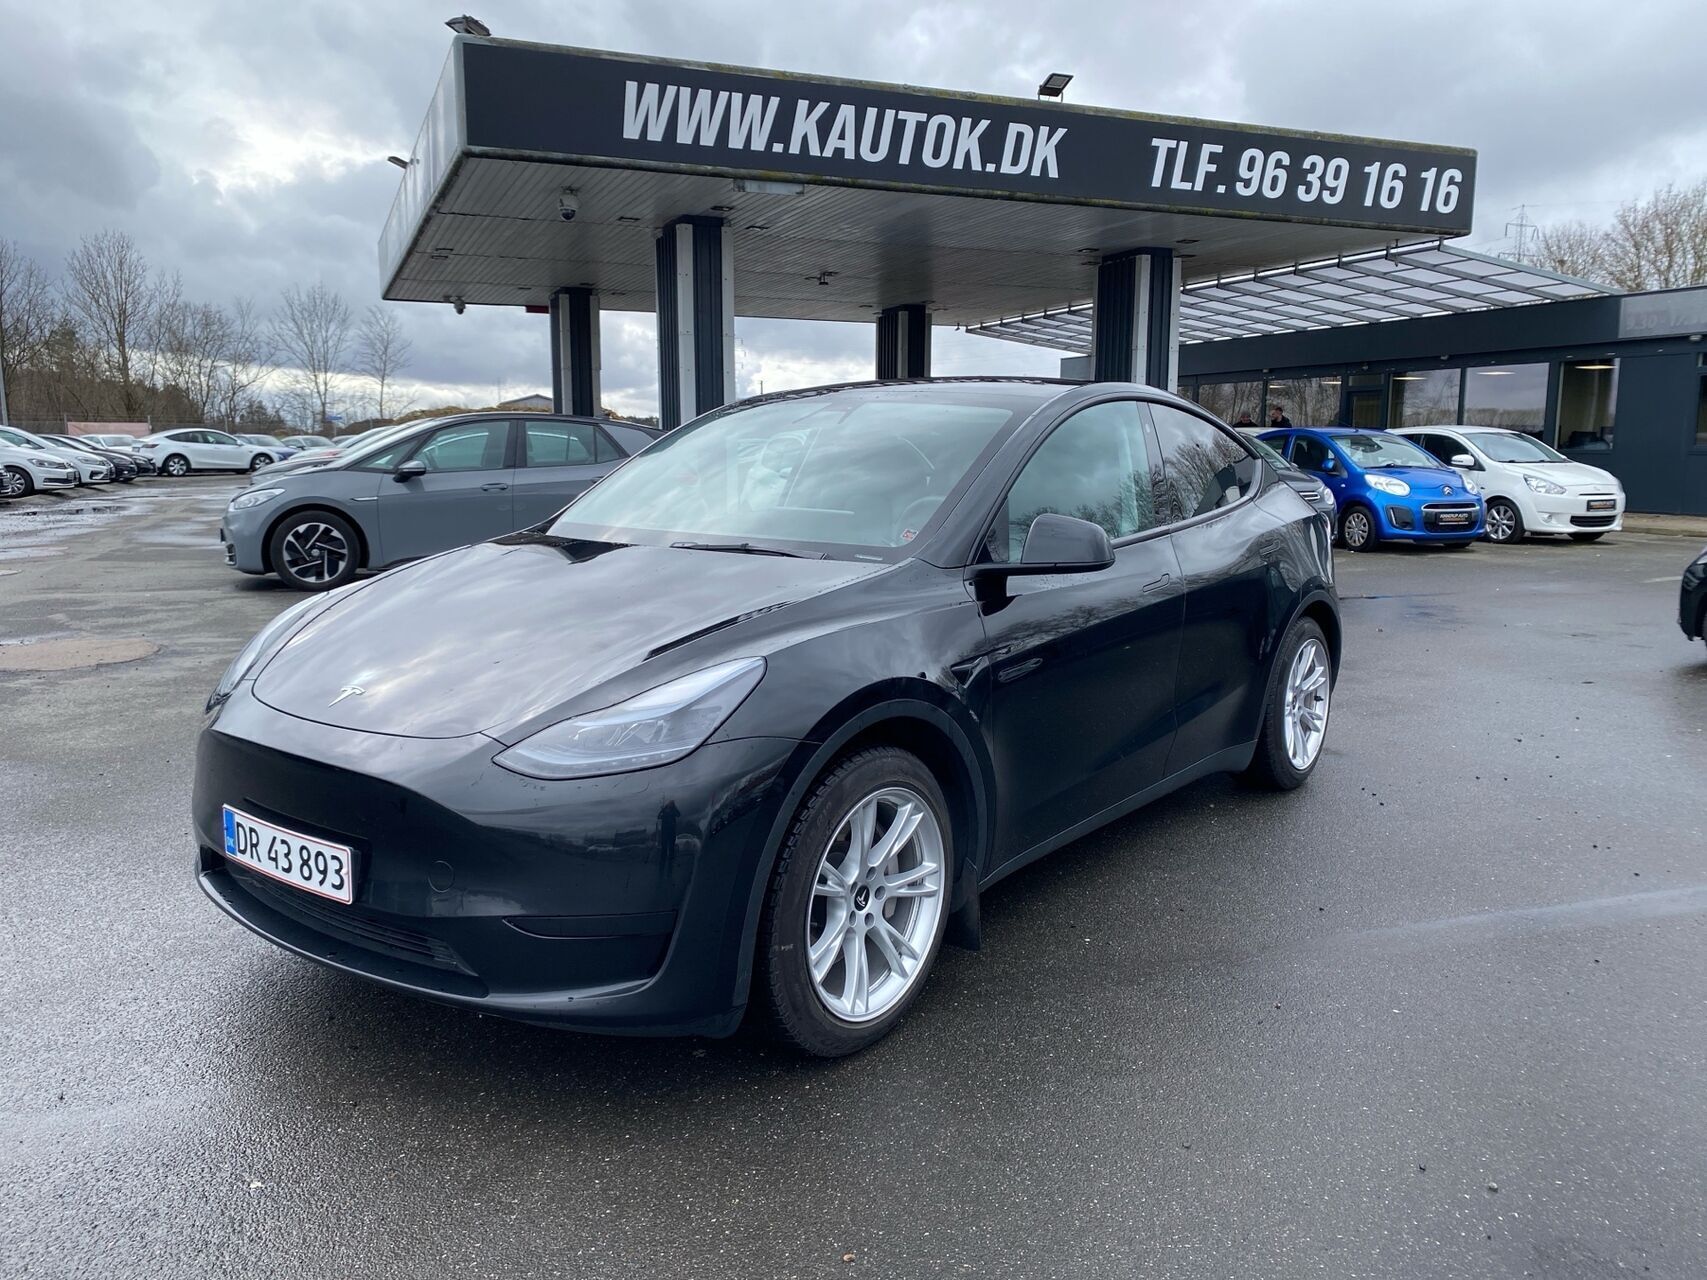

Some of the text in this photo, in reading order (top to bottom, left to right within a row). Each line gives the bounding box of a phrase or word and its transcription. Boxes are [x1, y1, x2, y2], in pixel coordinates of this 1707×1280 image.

[623, 81, 1068, 179] WWW.KAUTOK.DK
[1151, 138, 1463, 214] TLF. 96 39 16 16
[236, 822, 345, 891] DR 43 893
